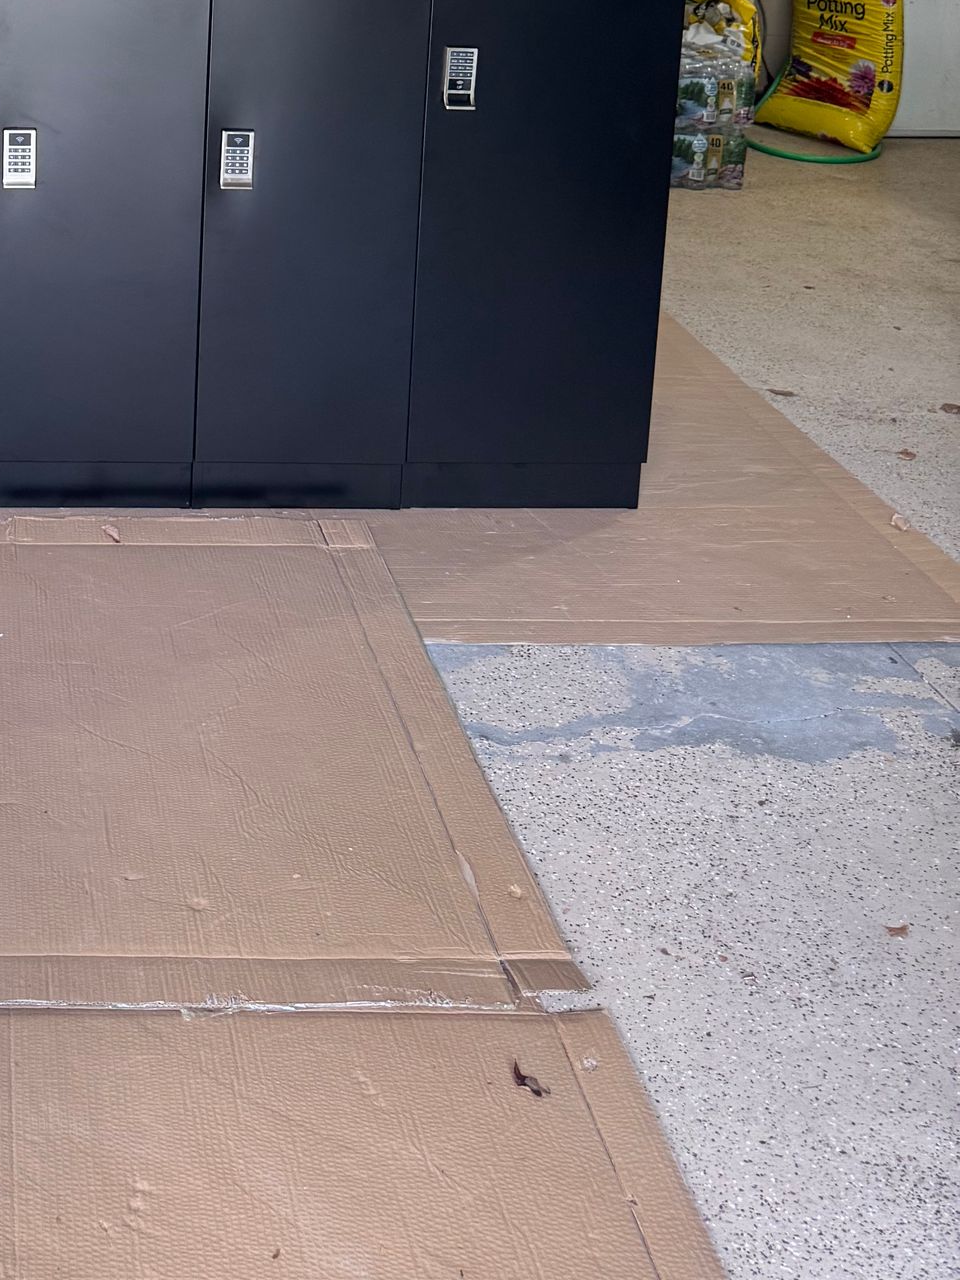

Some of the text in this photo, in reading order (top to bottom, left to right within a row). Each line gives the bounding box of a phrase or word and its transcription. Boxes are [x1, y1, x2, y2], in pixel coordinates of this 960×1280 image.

[818, 13, 848, 33] Mix
[882, 11, 895, 32] Mix
[881, 33, 897, 74] Potting
[720, 81, 734, 91] 40
[709, 137, 721, 148] 40
